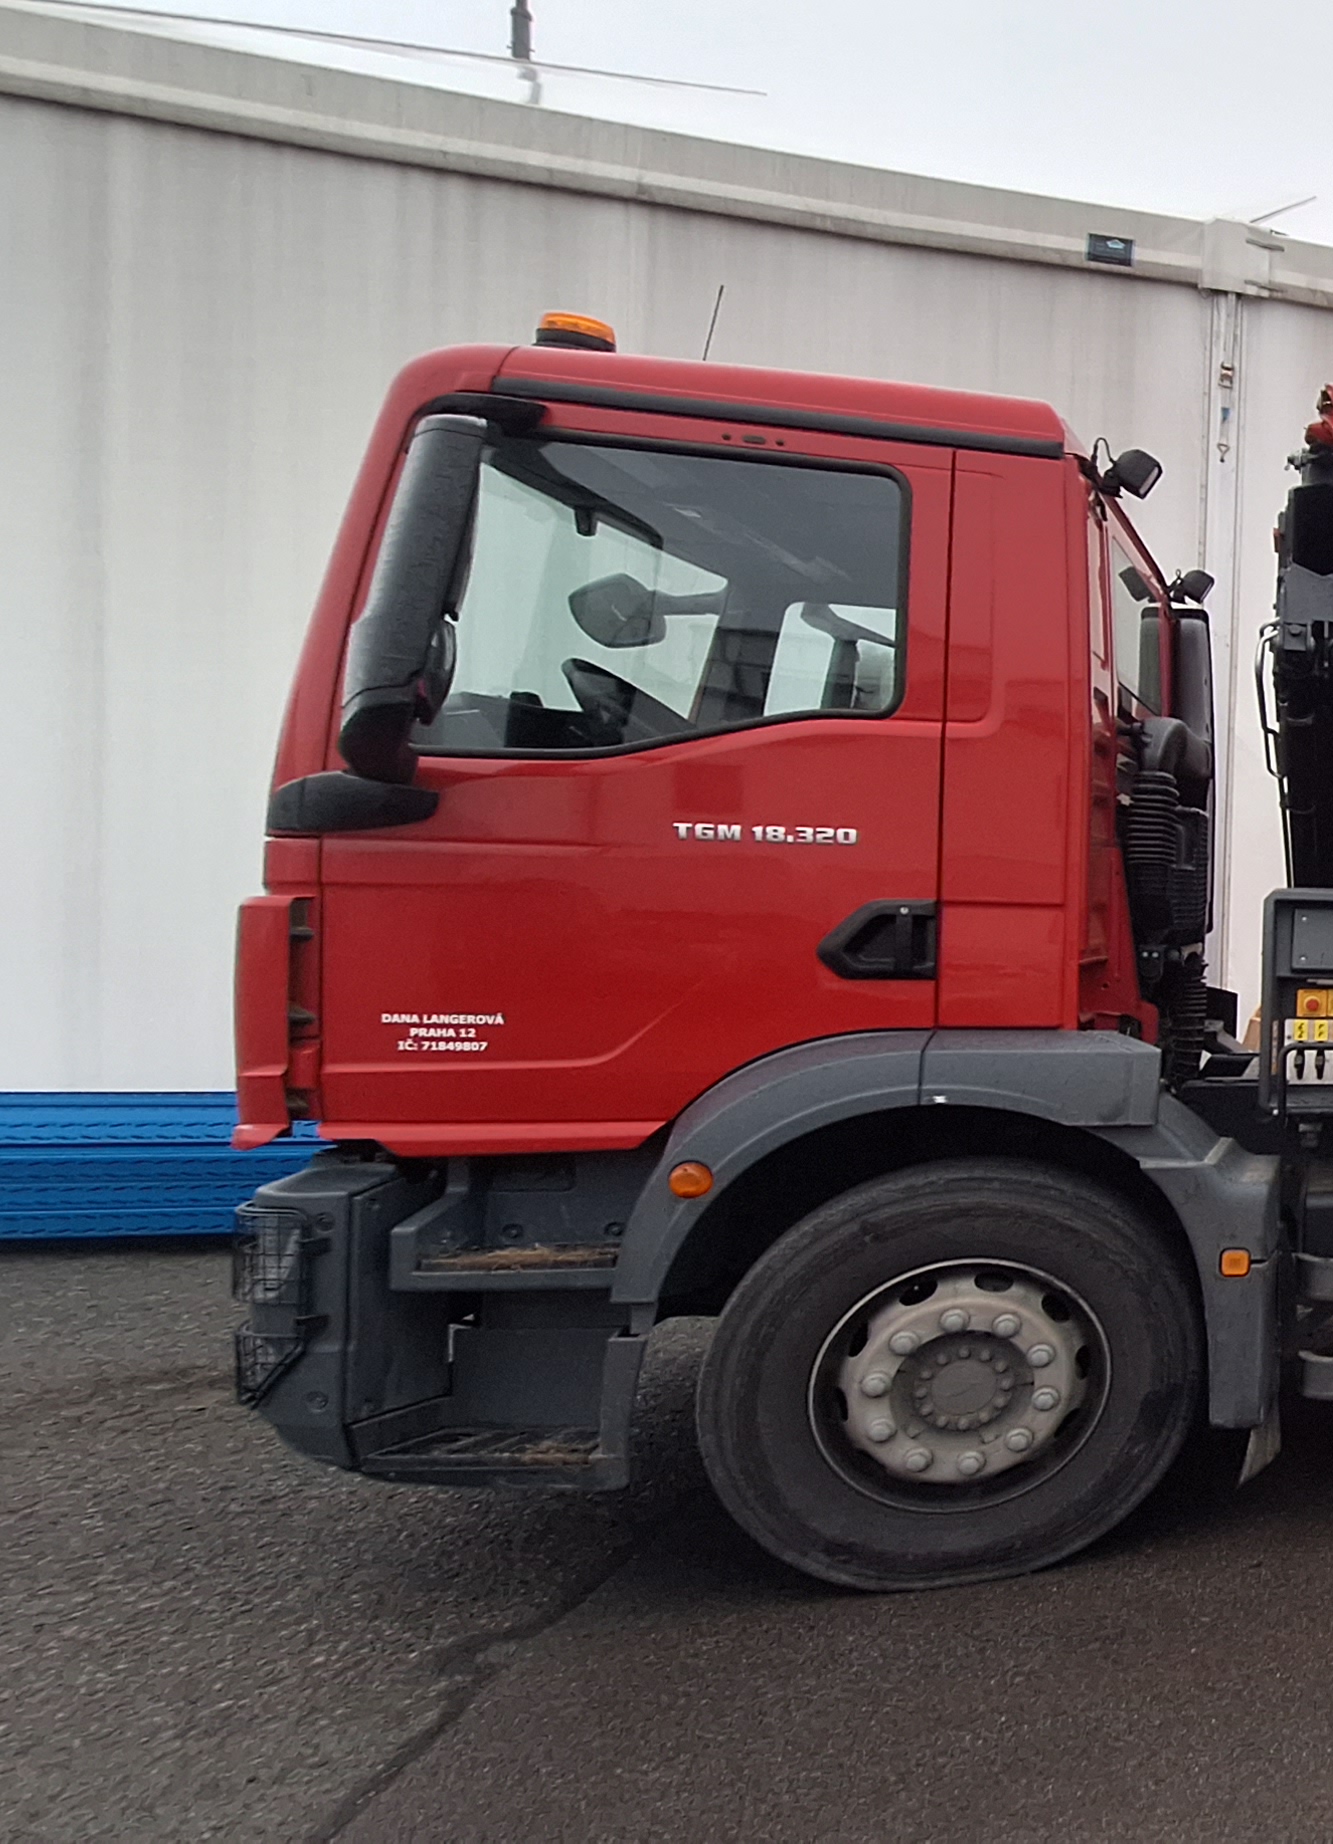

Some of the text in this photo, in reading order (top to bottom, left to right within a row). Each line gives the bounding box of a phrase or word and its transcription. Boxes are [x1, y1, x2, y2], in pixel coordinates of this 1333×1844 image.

[672, 822, 858, 845] TGM 18.320
[381, 1012, 505, 1025] DANA LANGEROVÁ
[409, 1027, 477, 1038] PRAHA 12
[397, 1038, 489, 1052] IČ: 71849807
